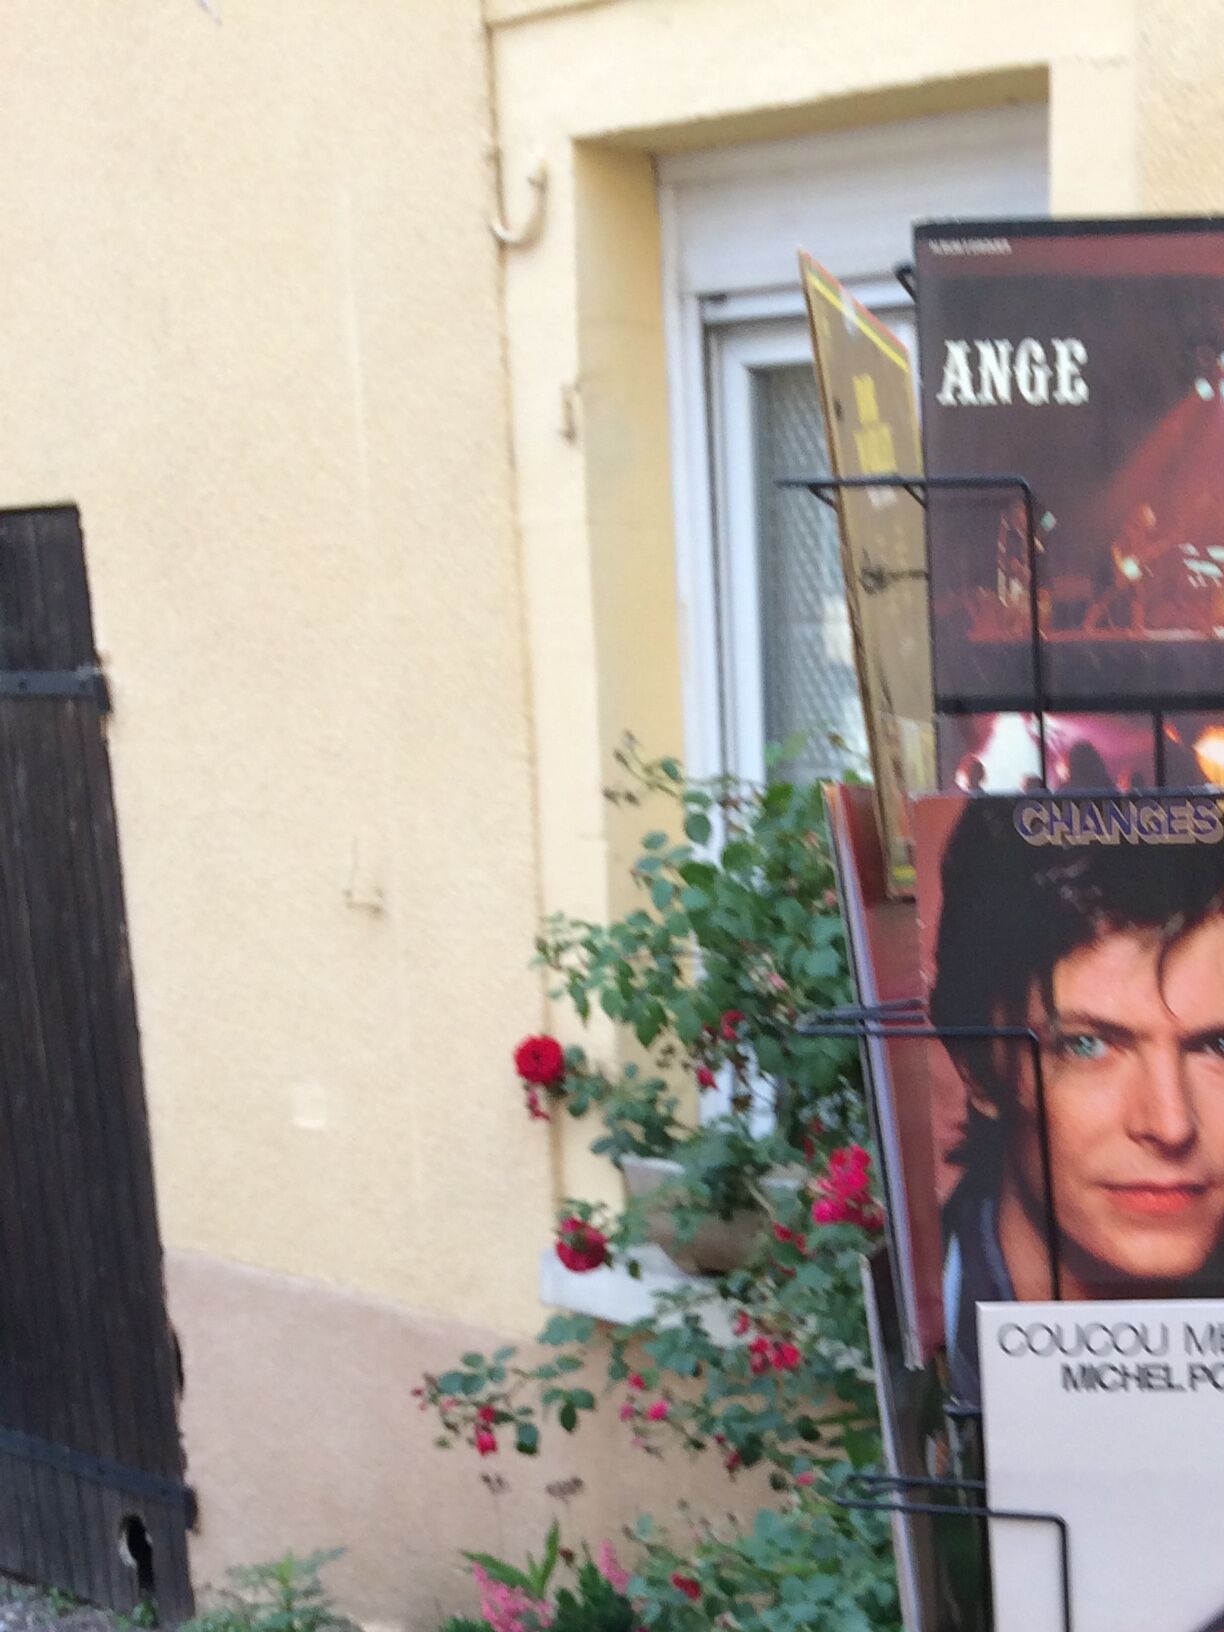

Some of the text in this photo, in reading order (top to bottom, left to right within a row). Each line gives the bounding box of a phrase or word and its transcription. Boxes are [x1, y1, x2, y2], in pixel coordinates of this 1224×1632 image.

[935, 336, 1090, 407] ANGE
[996, 1321, 1169, 1357] COUCOU
[1061, 1363, 1186, 1393] MICHEL
